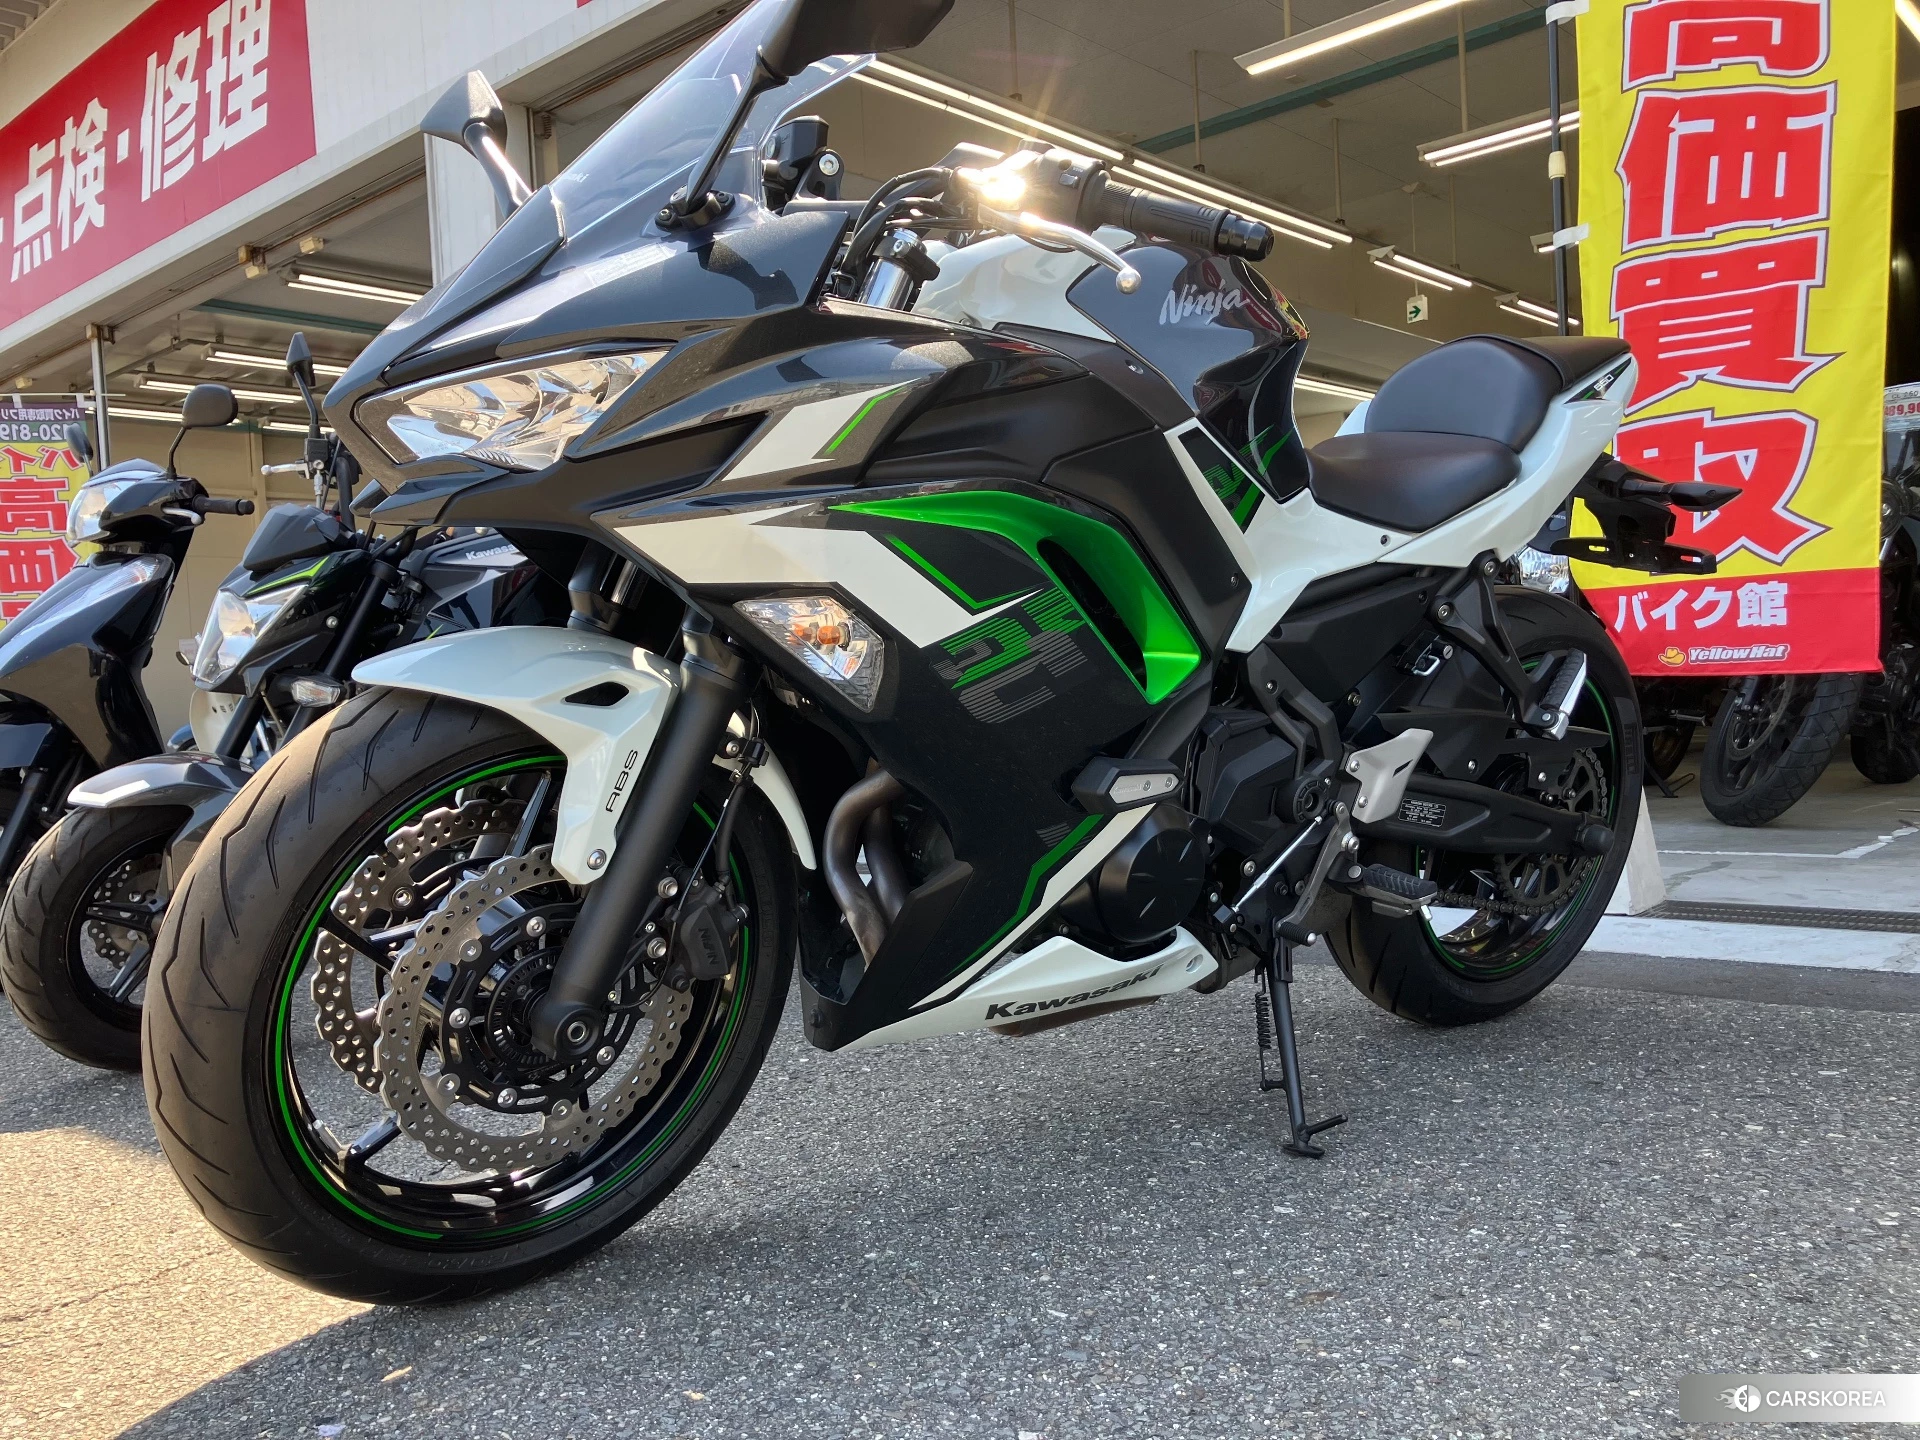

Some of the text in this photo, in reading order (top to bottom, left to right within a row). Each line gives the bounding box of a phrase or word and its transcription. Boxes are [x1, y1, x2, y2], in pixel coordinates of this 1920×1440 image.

[11, 0, 270, 282] 点検・修理
[1159, 279, 1250, 325] Ninja
[1614, 580, 1788, 632] バイク館
[605, 750, 639, 812] ABS
[985, 963, 1165, 1020] Kawasaki
